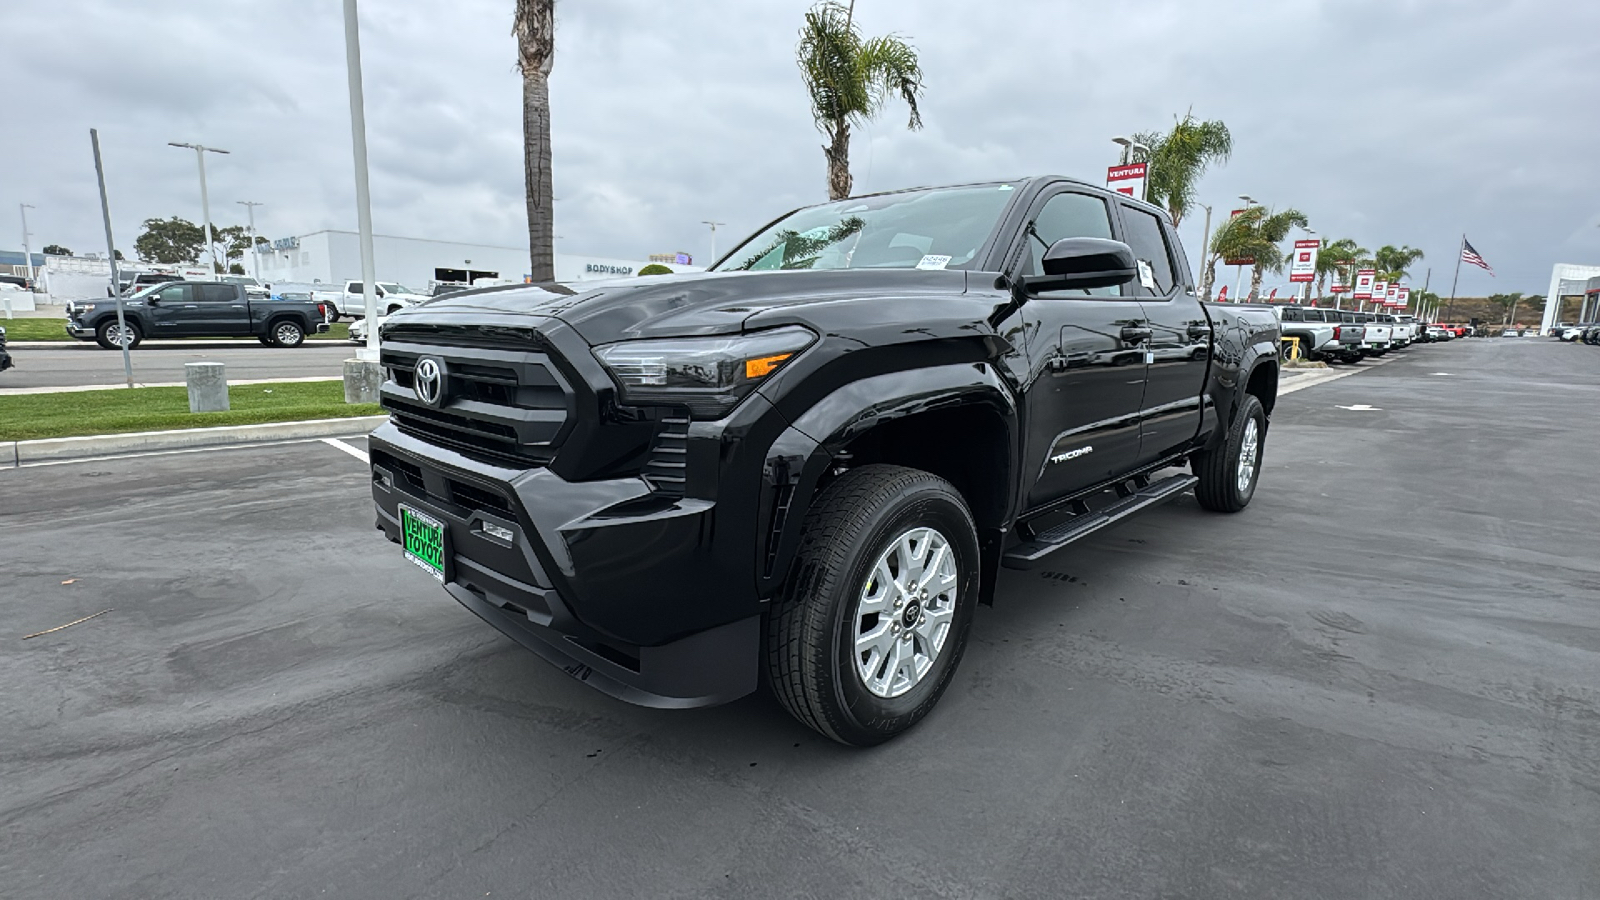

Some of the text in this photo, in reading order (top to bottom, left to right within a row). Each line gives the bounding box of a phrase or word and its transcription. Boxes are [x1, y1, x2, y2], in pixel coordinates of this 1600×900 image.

[1109, 167, 1144, 178] VENTURA
[586, 263, 633, 275] BODYSHOP
[1050, 445, 1093, 464] TACOMA
